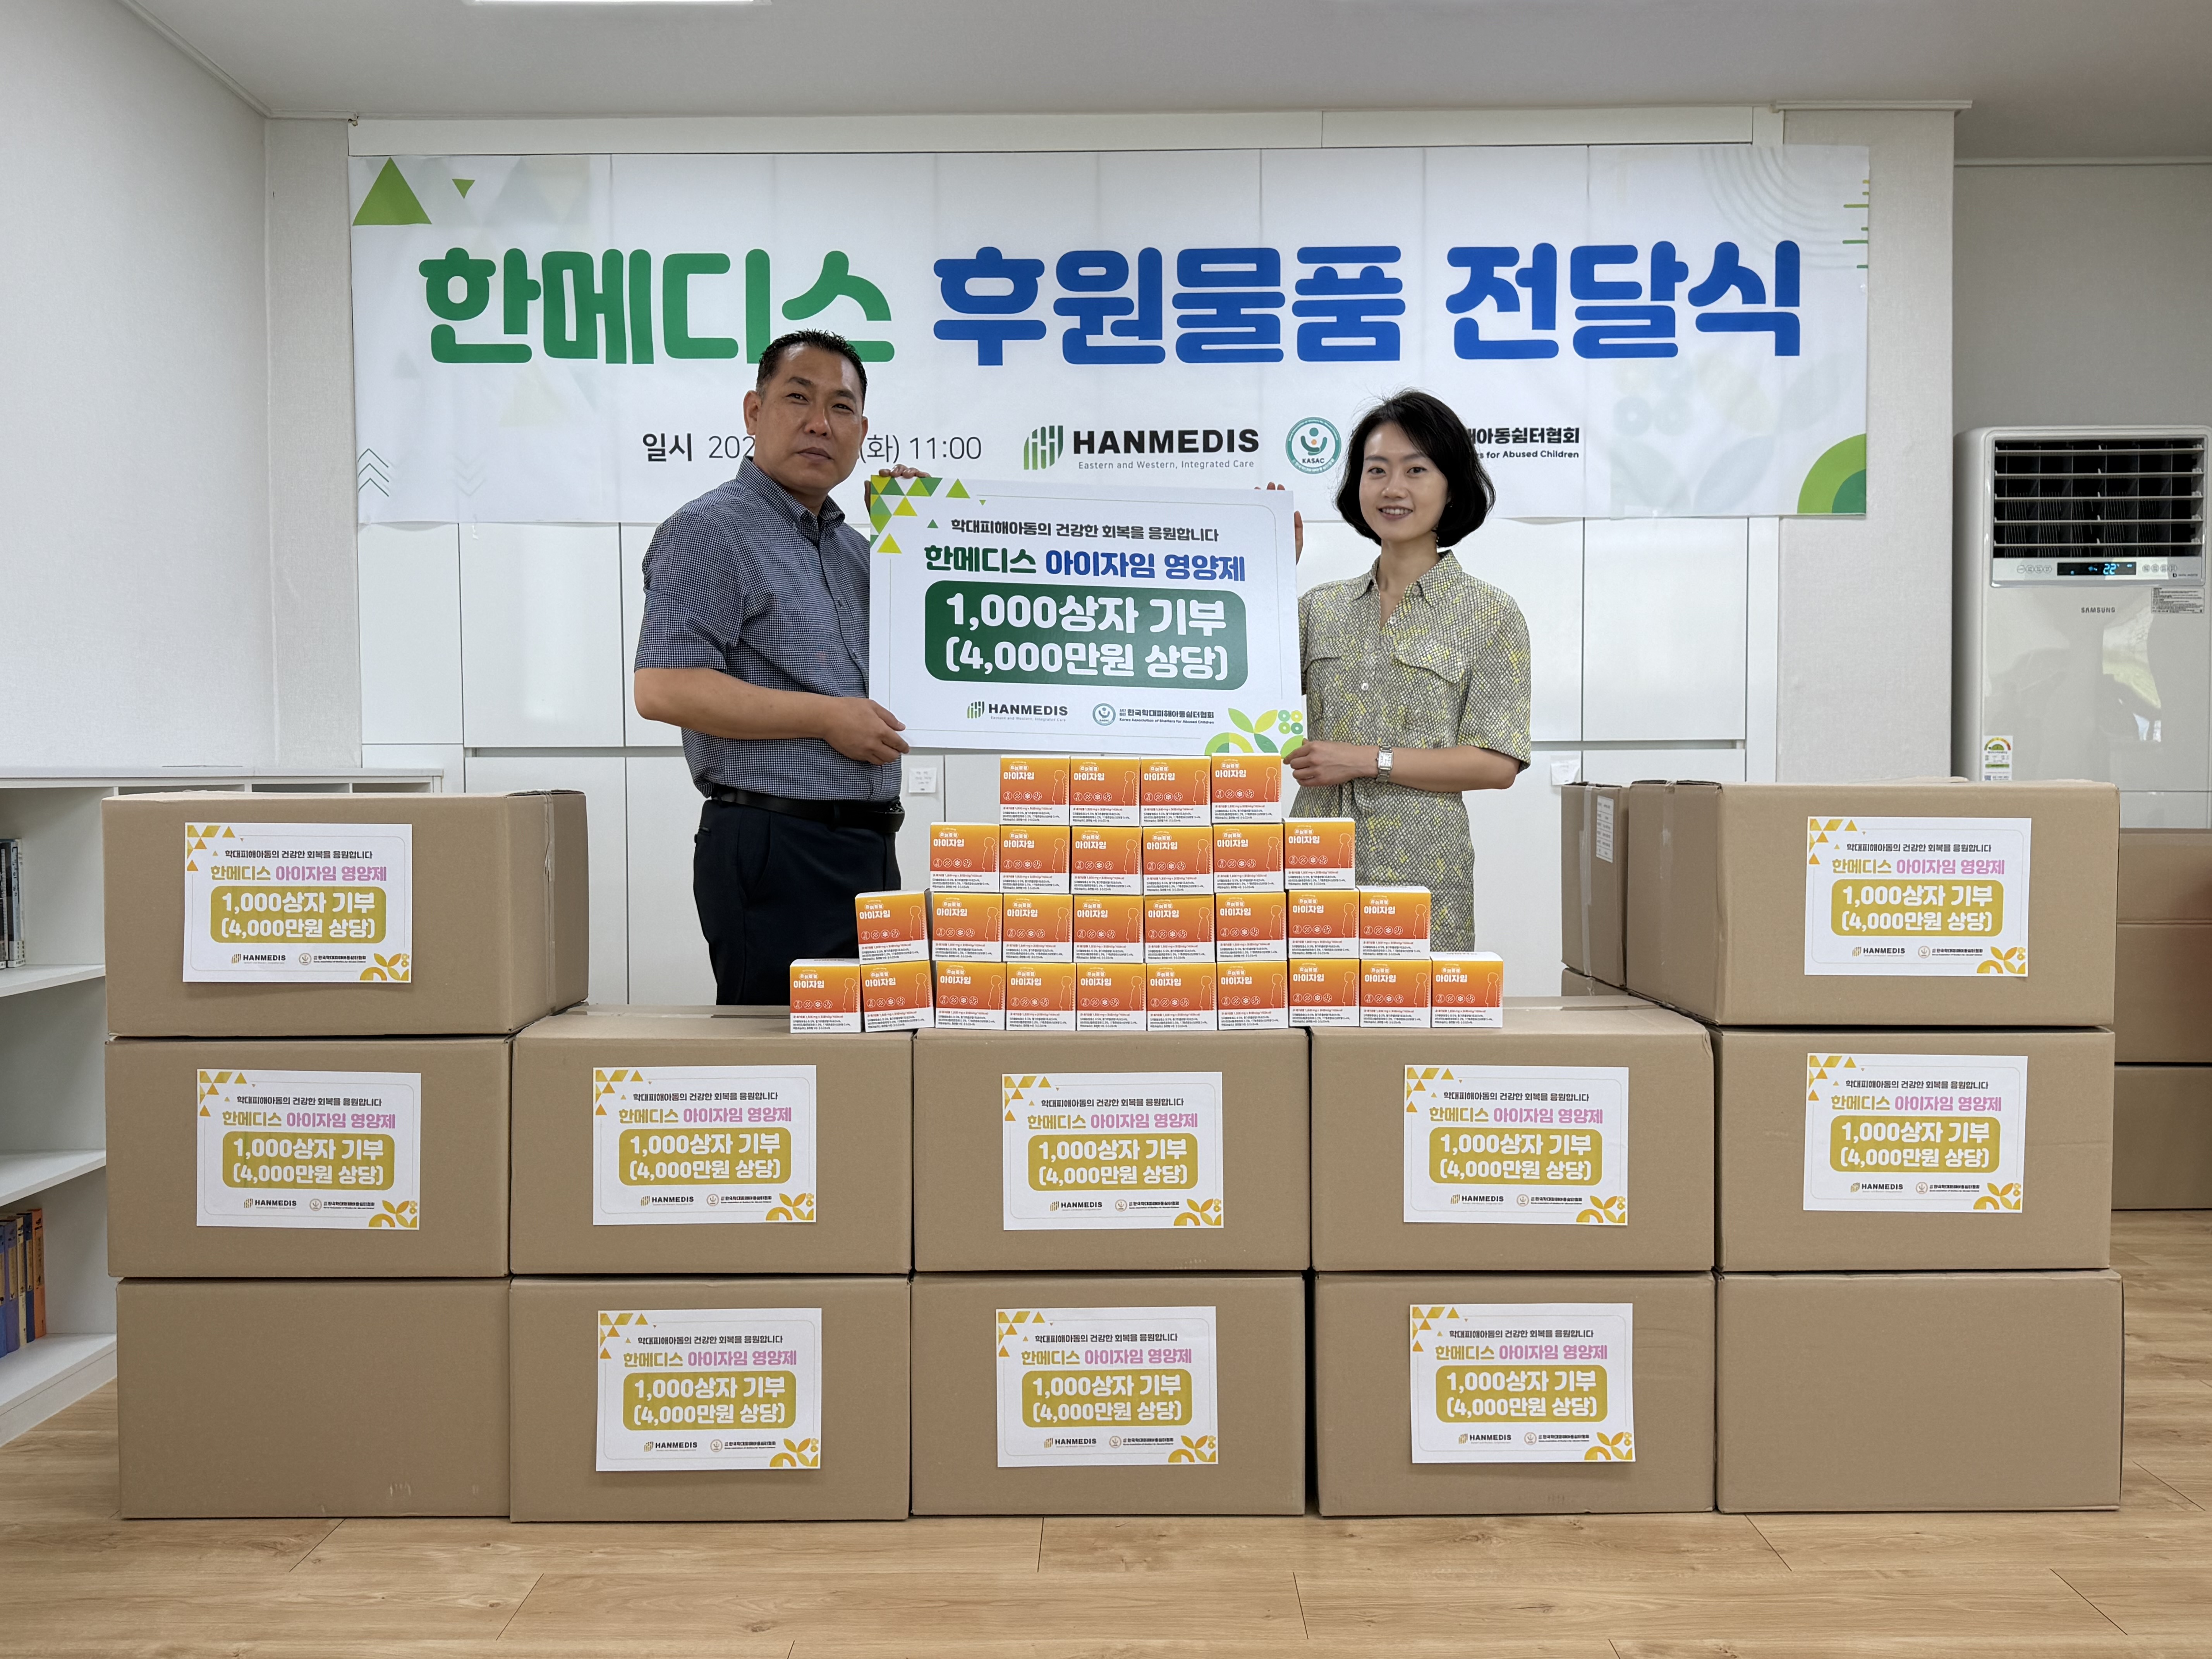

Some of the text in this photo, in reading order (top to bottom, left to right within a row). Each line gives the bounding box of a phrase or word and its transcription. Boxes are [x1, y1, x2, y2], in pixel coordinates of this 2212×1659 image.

[419, 240, 1800, 366] 한메디스 후원물품 전달식
[642, 433, 692, 462] 일시
[709, 436, 755, 459] 202
[910, 436, 981, 459] 11:00
[1073, 429, 1259, 454] HANMEDIS
[1540, 450, 1579, 458] Children
[1136, 461, 1178, 469] Western,
[1182, 460, 1230, 470] Integrated
[1233, 460, 1254, 468] Care
[951, 519, 1219, 542] 학대피해아동의 건강한 회복을 응원합니다
[924, 545, 1245, 582] 한메디스 아이자임 영양제
[2103, 563, 2117, 575] 22
[946, 593, 1226, 637] 1,000상자 기부
[946, 636, 1228, 681] (4,000만원 상당)
[988, 704, 1068, 716] HANMEDIS
[1144, 773, 1175, 781] 아이자임
[1215, 769, 1246, 778] 아이자임
[1075, 841, 1106, 849] 아이자임
[1147, 842, 1177, 850] 아이자임
[1217, 839, 1248, 847] 아이자임
[1288, 835, 1319, 844] 아이자임
[1903, 844, 1926, 852] 건강한
[282, 850, 306, 859] 건강한
[210, 866, 386, 881] 한메디스 아이자임 영양제
[1832, 859, 2005, 874] 한메디스 아이자임 영양제
[222, 891, 375, 914] 1,000상자 기부
[1843, 885, 1993, 907] 1,000상자 기부
[859, 909, 890, 920] 아이자임
[1364, 906, 1395, 914] 아이자임
[221, 917, 374, 938] (4,000만원 상당)
[1842, 910, 1992, 932] (4,000만원 상당)
[793, 980, 824, 988] 아이자임
[1096, 1099, 1119, 1107] 건강한
[1831, 1095, 2002, 1111] 한메디스 아이자임 영양제
[222, 1111, 395, 1129] 한메디스 아이자임 영양제
[619, 1107, 792, 1123] 한메디스 아이자임 영양제
[1027, 1113, 1197, 1129] 한메디스 아이자임 영양제
[1429, 1107, 1603, 1124] 한메디스 아이자임 영양제
[1842, 1121, 1989, 1144] 1,000상자 기부
[234, 1138, 383, 1160] 1,000상자 기부
[630, 1133, 780, 1157] 1,000상자 기부
[1039, 1139, 1187, 1163] 1,000상자 기부
[1440, 1133, 1591, 1156] 1,000상자 기부
[1841, 1147, 1989, 1168] (4,000만원 상당)
[233, 1163, 383, 1185] (4,000만원 상당)
[630, 1158, 780, 1181] (4,000만원 상당)
[1039, 1164, 1187, 1186] (4,000만원 상당)
[1440, 1158, 1591, 1180] (4,000만원 상당)
[623, 1350, 797, 1367] 한메디스 아이자임 영양제
[1021, 1348, 1192, 1365] 한메디스 아이자임 영양제
[1435, 1344, 1607, 1360] 한메디스 아이자임 영양제
[634, 1376, 785, 1401] 1,000상자 기부
[1033, 1374, 1181, 1398] 1,000상자 기부
[1447, 1370, 1597, 1394] 1,000상자 기부
[633, 1402, 785, 1426] (4,000만원 상당)
[1033, 1400, 1182, 1423] (4,000만원 상당)
[1447, 1396, 1597, 1418] (4,000만원 상당)
